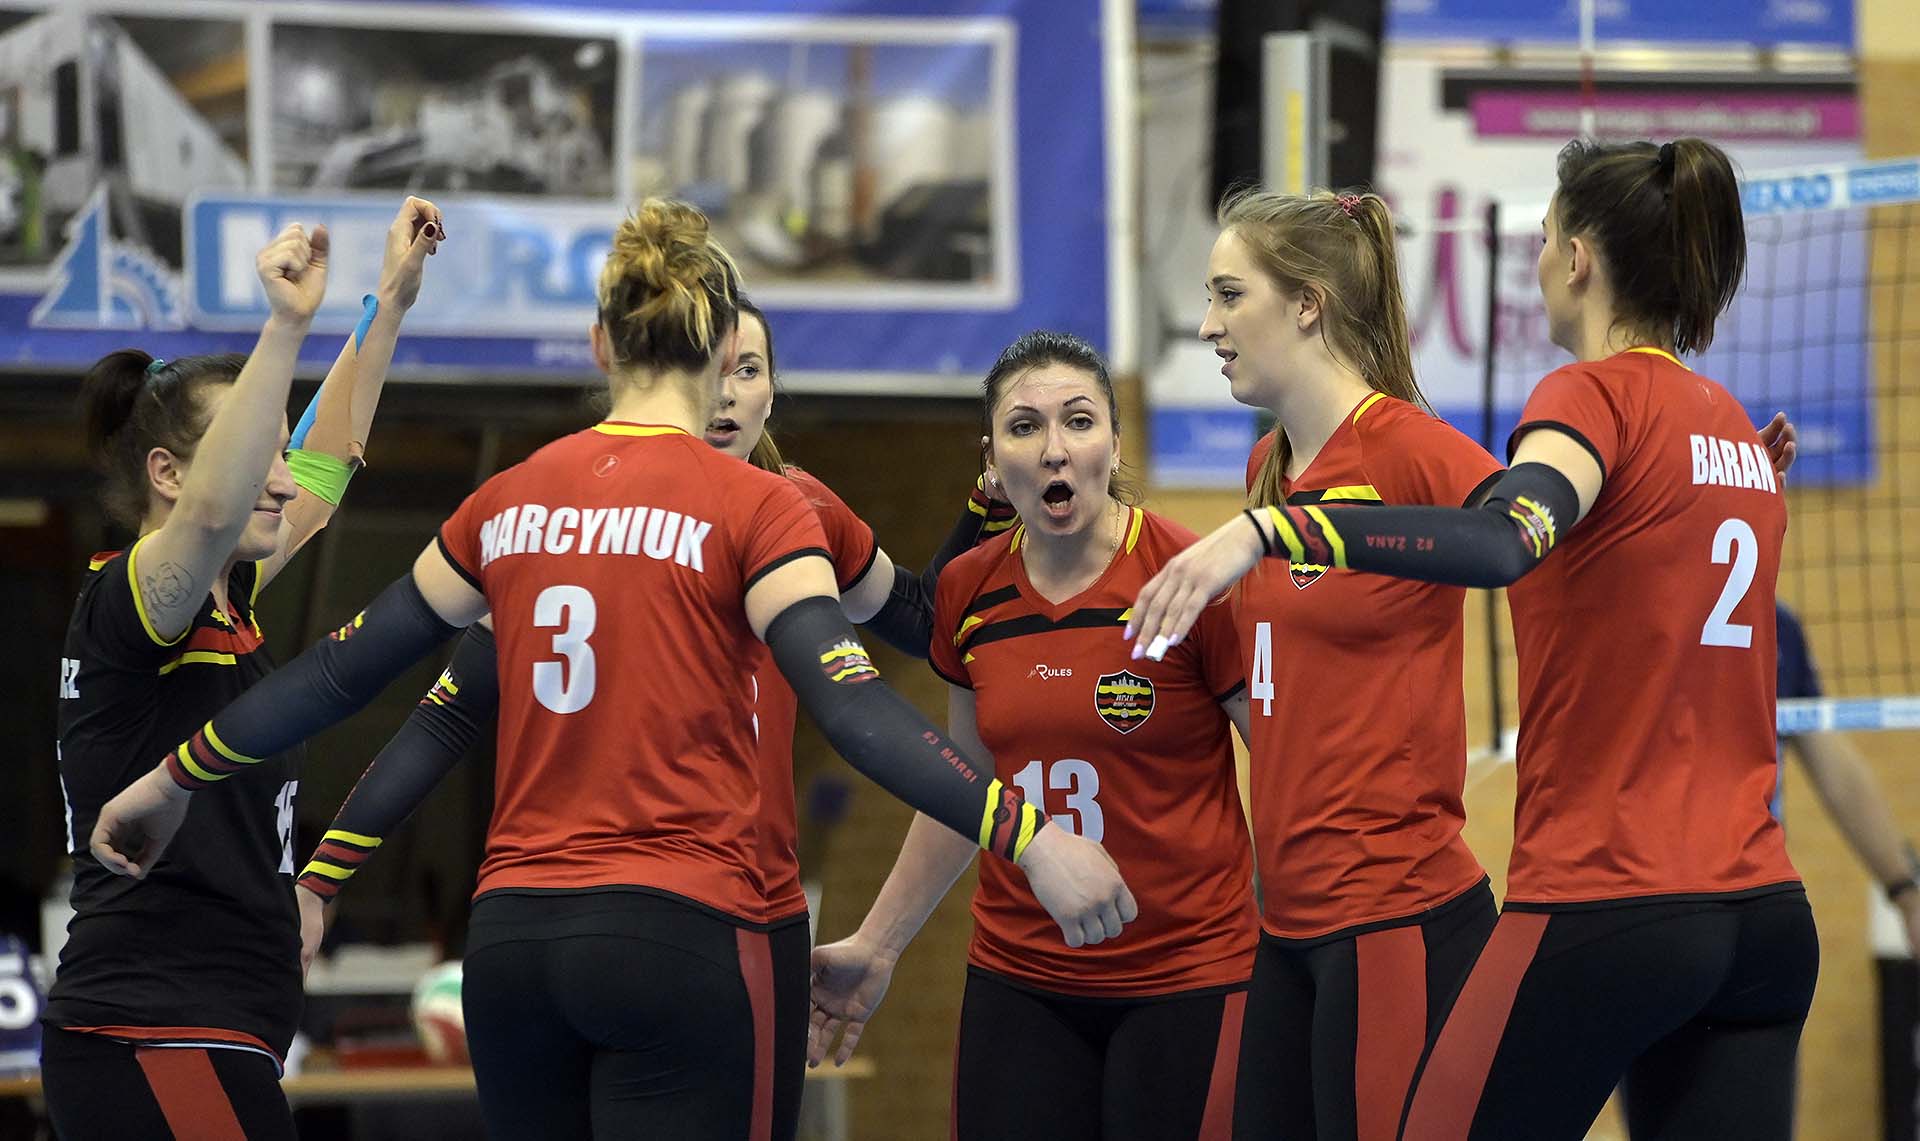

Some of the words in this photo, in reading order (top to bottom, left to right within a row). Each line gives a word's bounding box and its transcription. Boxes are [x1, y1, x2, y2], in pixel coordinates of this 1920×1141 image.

[1689, 433, 1777, 494] BARAN
[480, 503, 713, 574] MARCYNIUK
[1700, 517, 1759, 649] 2
[532, 584, 597, 715] 3
[1251, 621, 1275, 717] 4
[940, 746, 978, 783] MARSI
[1012, 758, 1105, 844] 13
